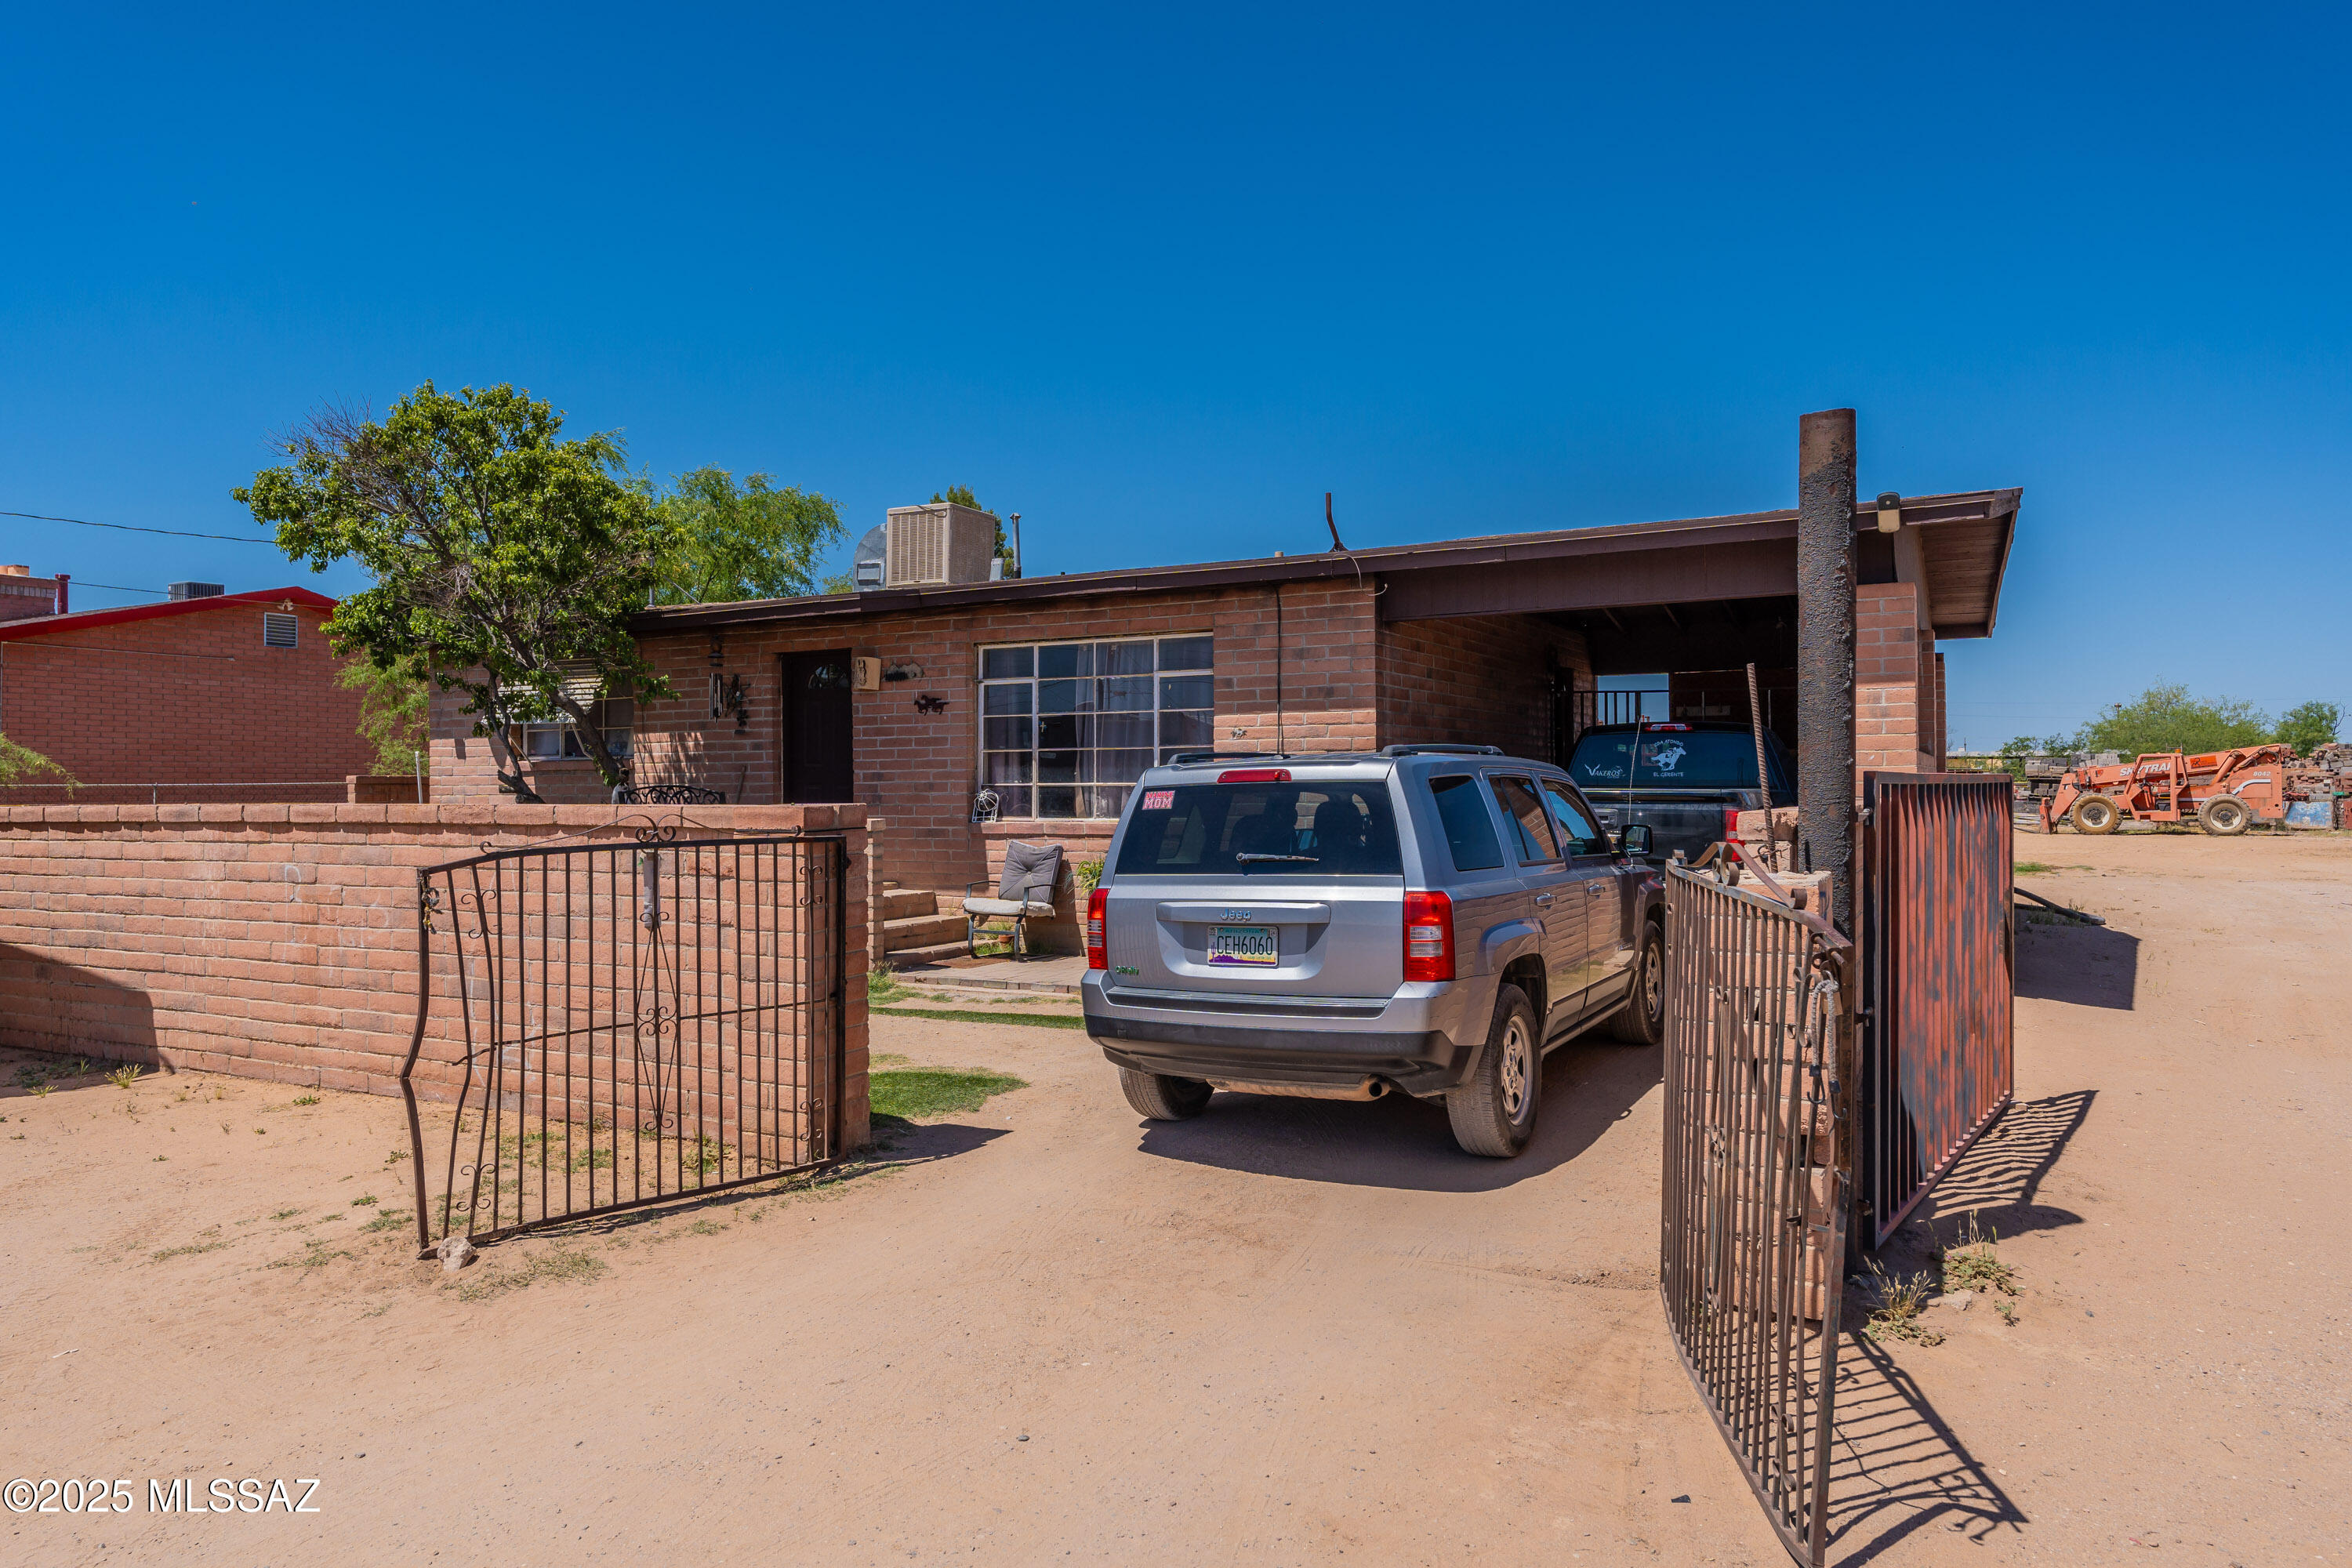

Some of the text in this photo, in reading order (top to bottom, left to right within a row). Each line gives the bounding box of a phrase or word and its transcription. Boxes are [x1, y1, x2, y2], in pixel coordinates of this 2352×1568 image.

[2119, 762, 2171, 776] SKYTRA
[1144, 798, 1172, 808] MOM
[1220, 908, 1252, 921] Jeep
[1217, 935, 1273, 955] CEH6060
